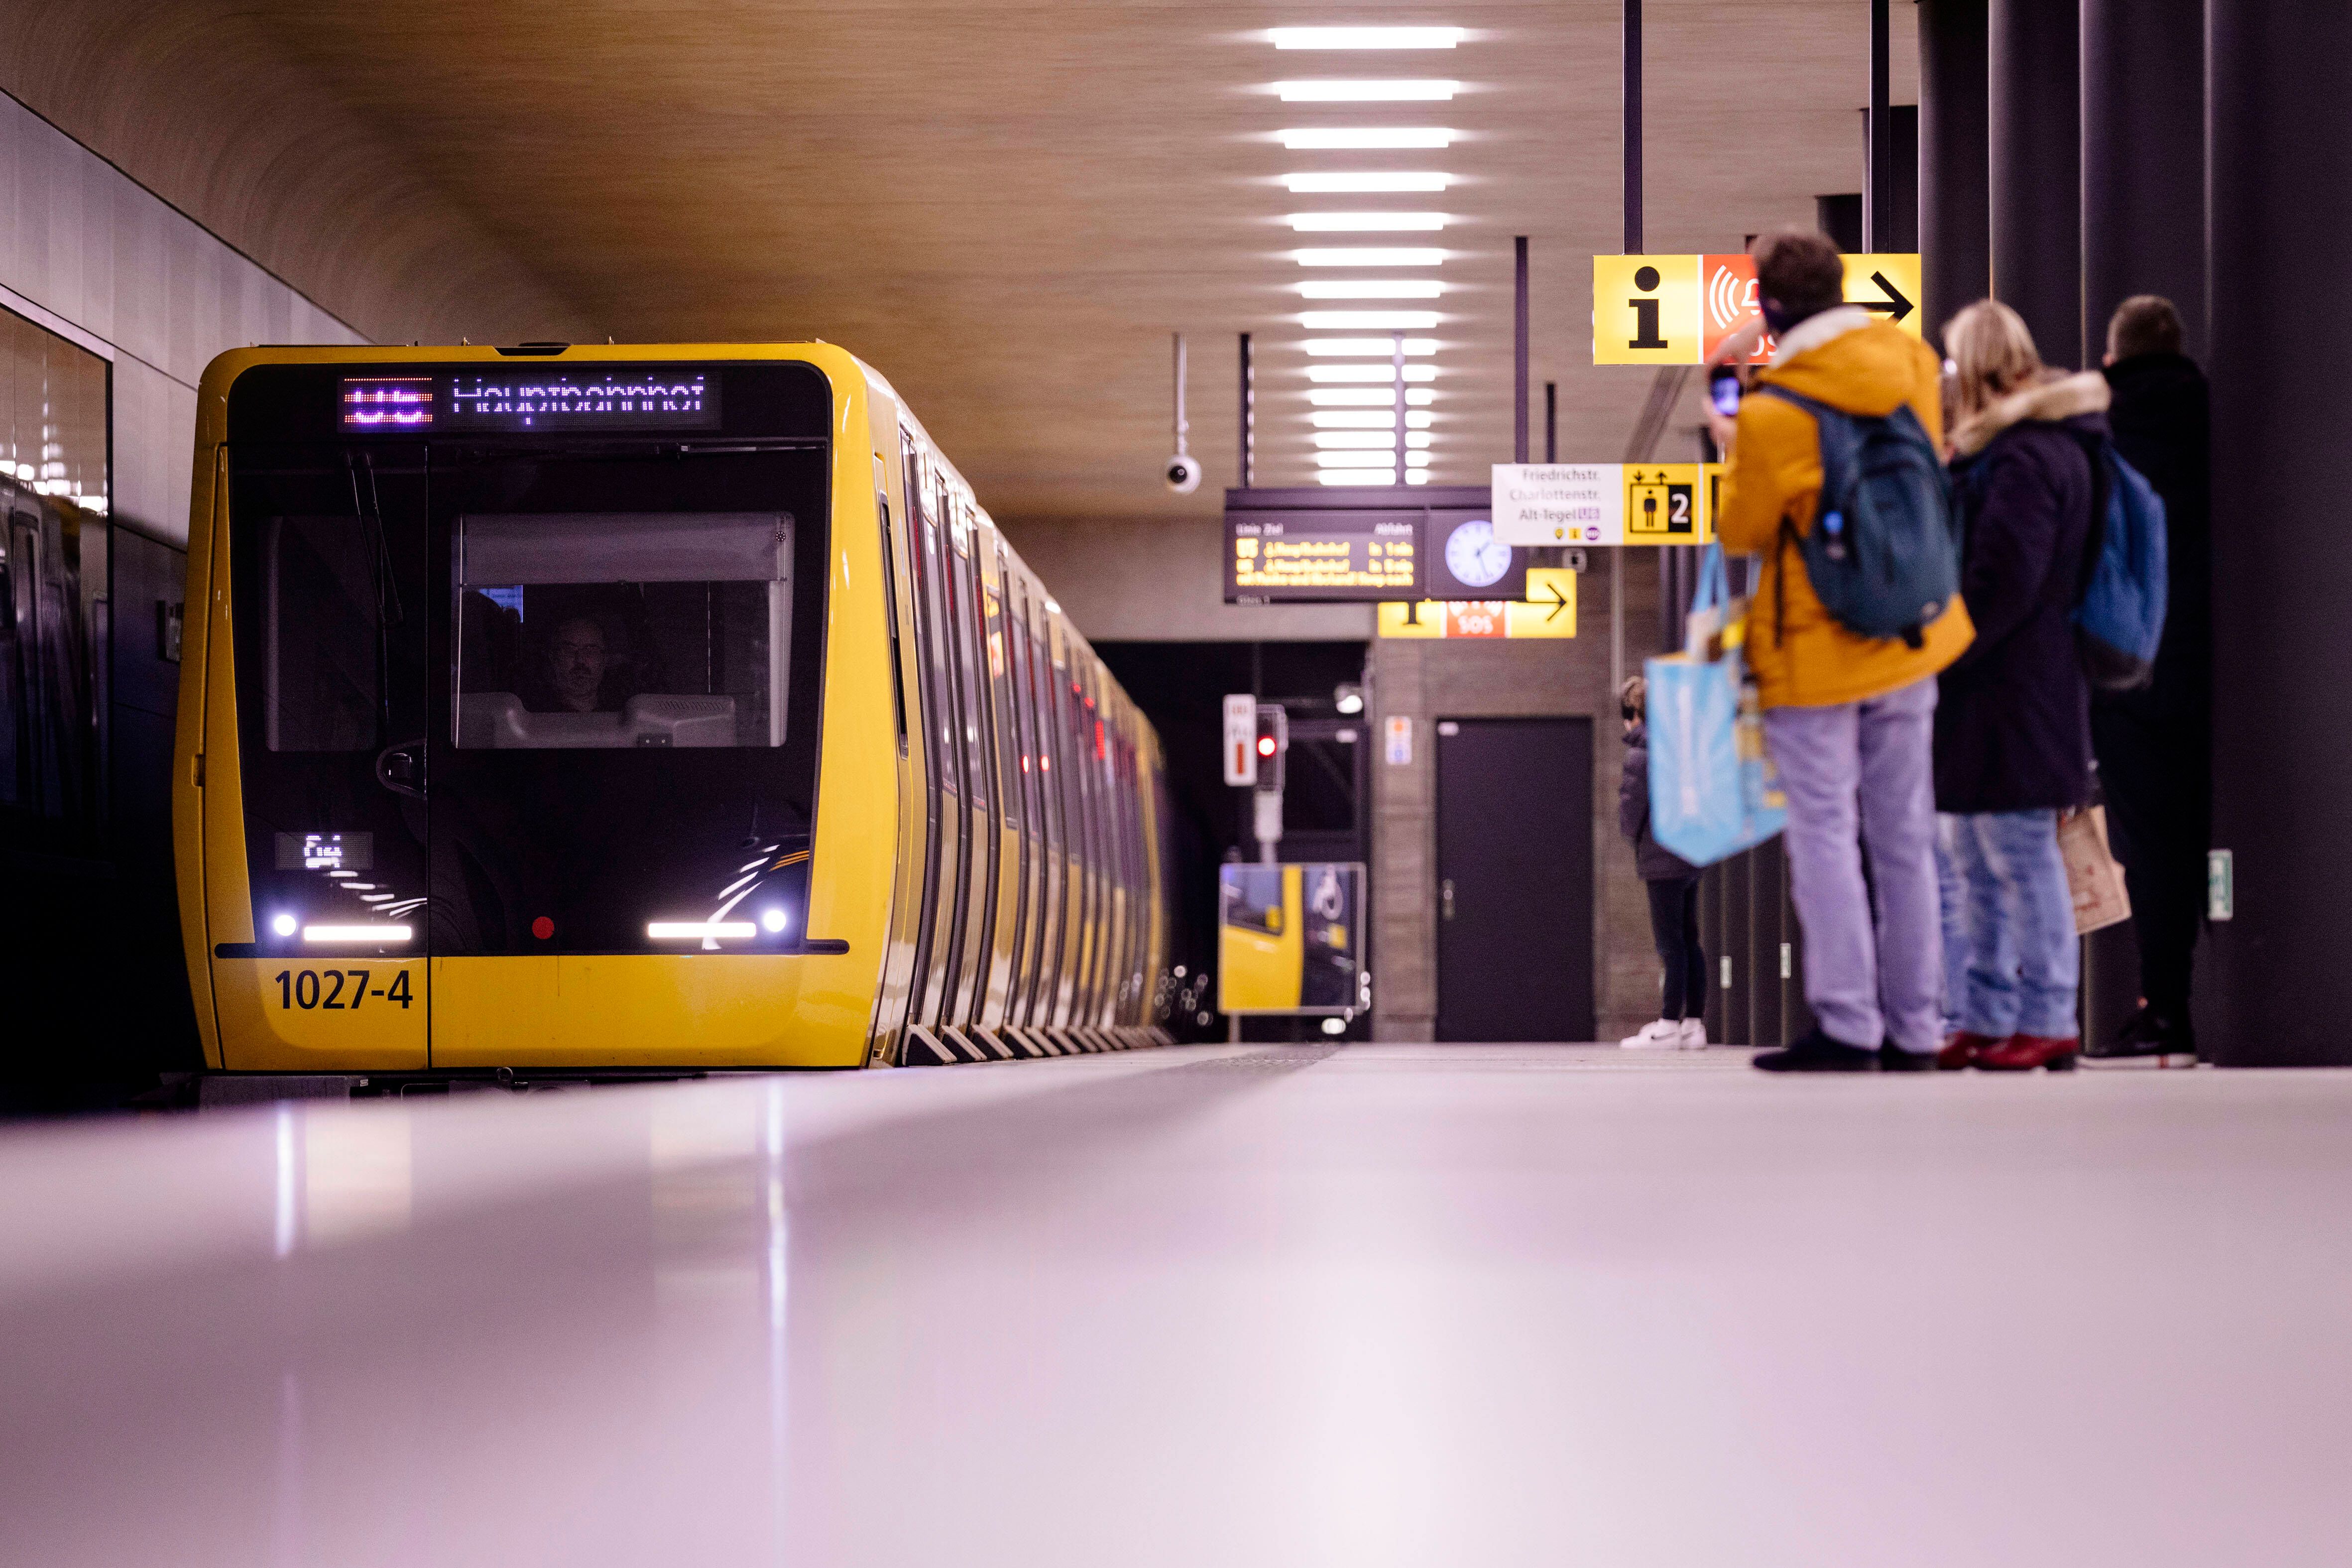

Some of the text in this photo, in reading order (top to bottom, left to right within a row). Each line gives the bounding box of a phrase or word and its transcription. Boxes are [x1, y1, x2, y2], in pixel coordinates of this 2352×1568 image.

[454, 376, 705, 425] Hauptbahnhof
[1522, 468, 1601, 481] Friedrichstr.
[1509, 488, 1601, 501] Charlottenstr.
[1519, 507, 1576, 523] Alt-Tegel
[1670, 492, 1689, 524] 2
[1458, 615, 1493, 634] SOS
[275, 969, 413, 1009] 1027-4
